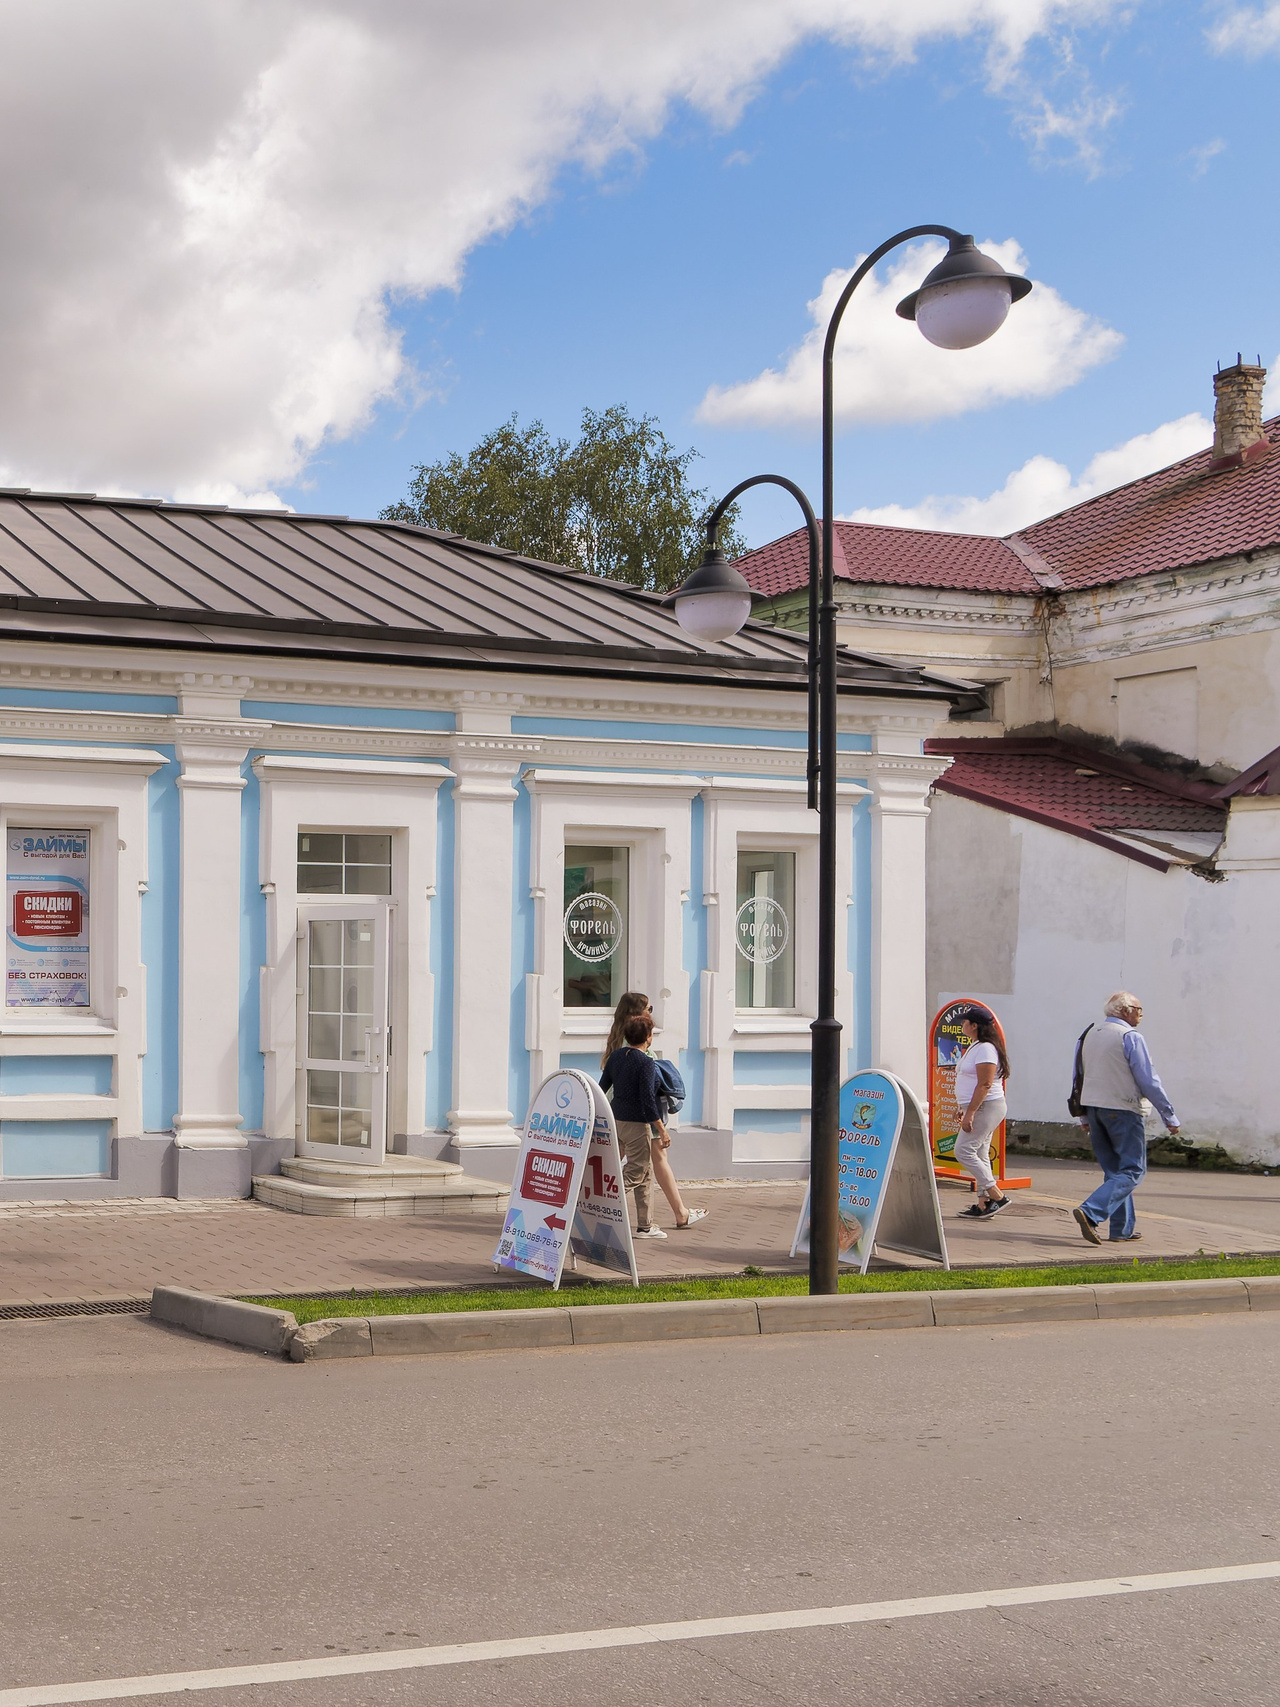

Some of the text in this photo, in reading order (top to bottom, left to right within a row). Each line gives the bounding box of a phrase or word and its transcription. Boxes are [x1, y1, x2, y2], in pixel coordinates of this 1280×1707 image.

[23, 835, 87, 852] ЗАЙМЫ
[23, 896, 72, 913] СКИДКИ
[28, 972, 87, 980] СТРАХОВОК!
[853, 1089, 885, 1100] магазин
[530, 1112, 587, 1139] ЗАЙМЫ
[533, 1132, 557, 1143] выгодой
[557, 1138, 568, 1146] для
[568, 1139, 583, 1149] Вас!
[839, 1128, 881, 1147] Форель
[531, 1155, 568, 1178] СКИДКИ
[855, 1166, 878, 1179] 18.00
[849, 1194, 871, 1207] 16.00
